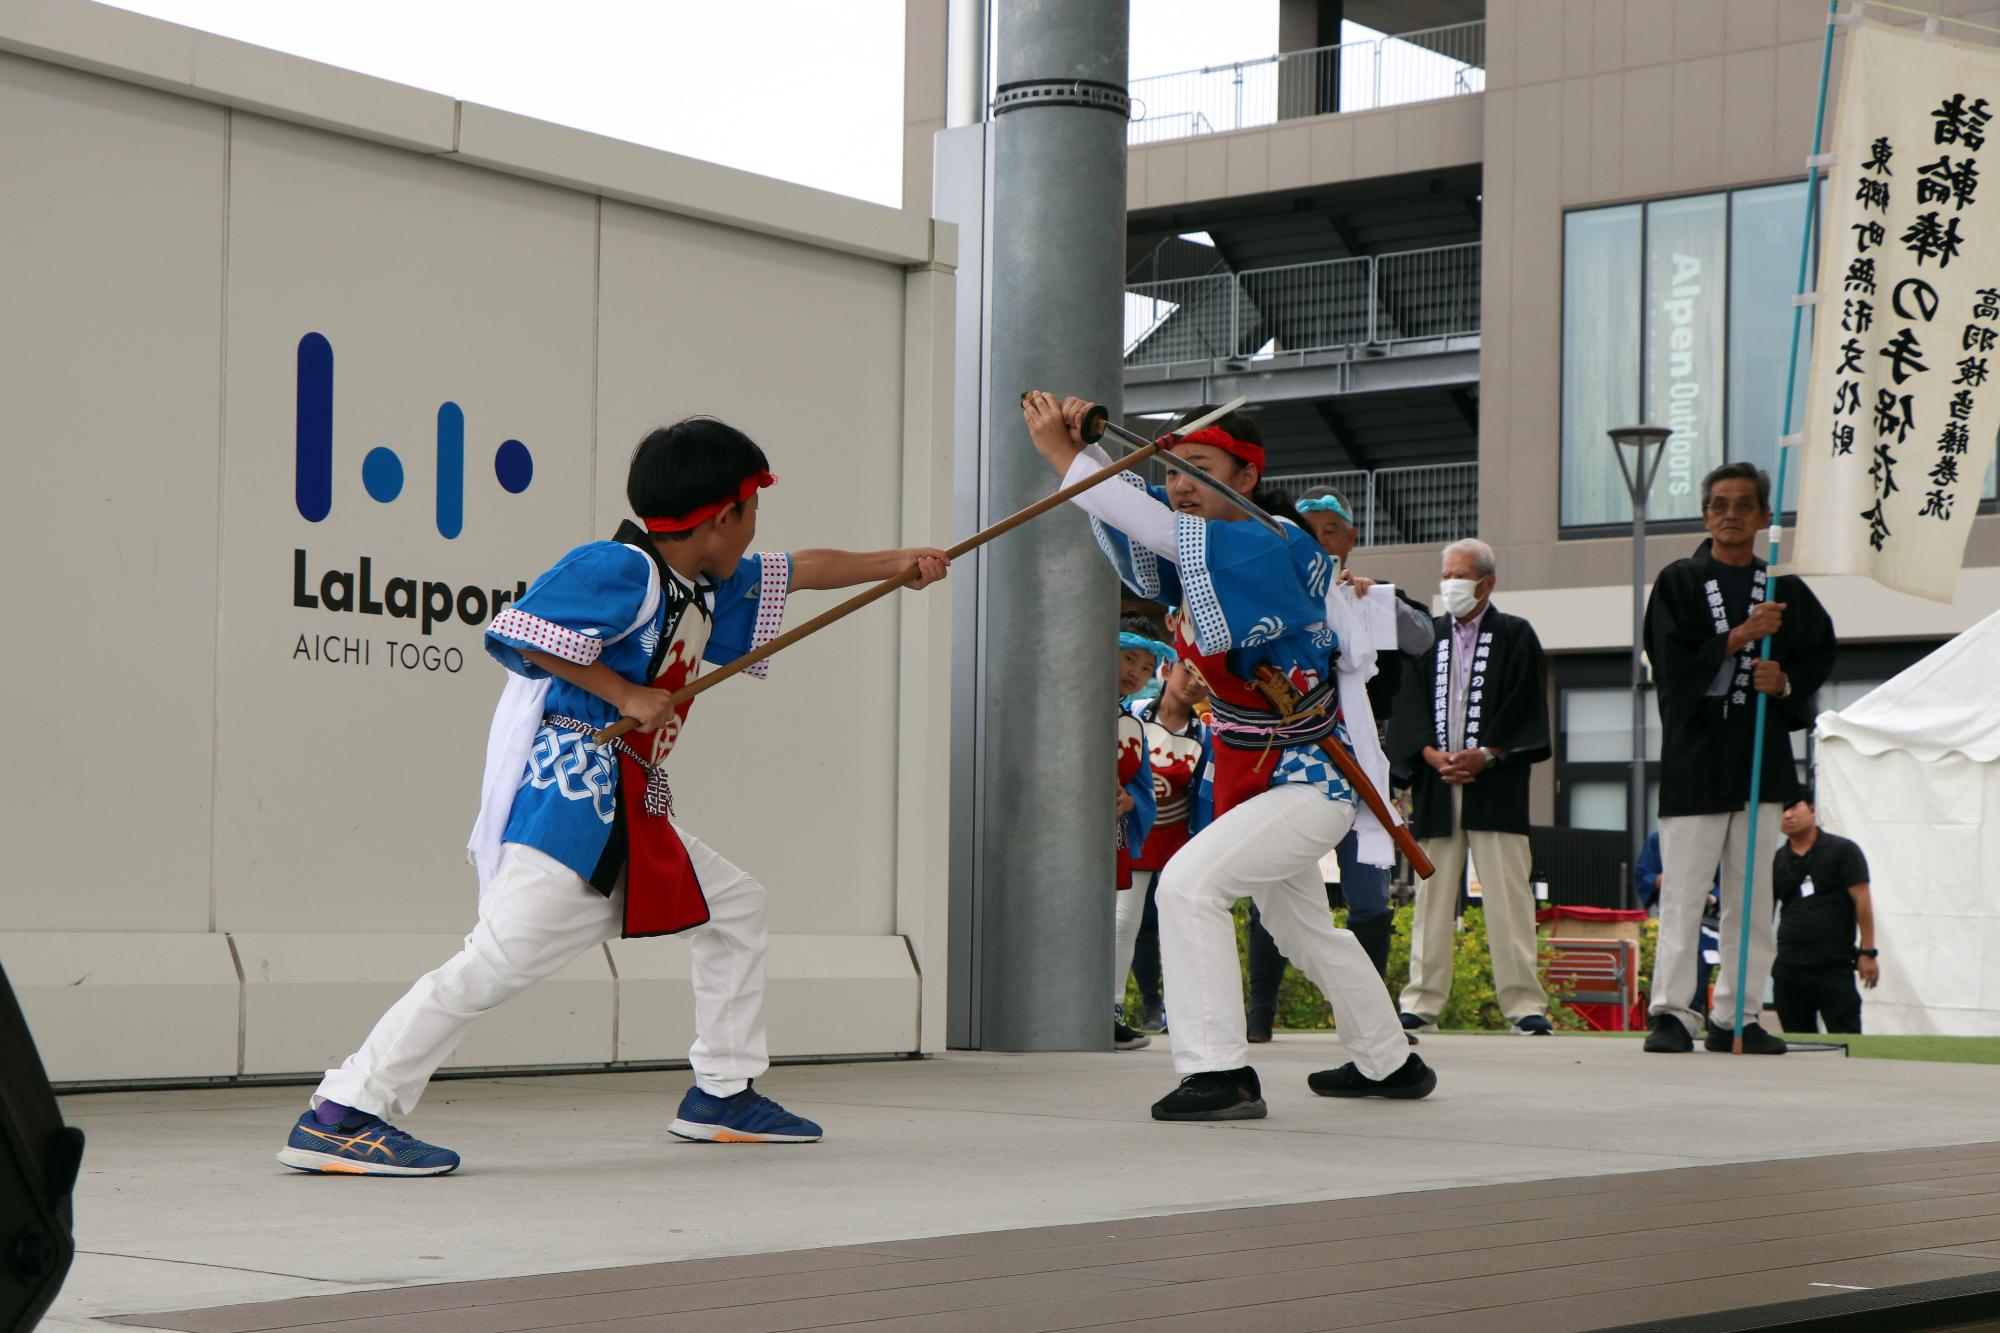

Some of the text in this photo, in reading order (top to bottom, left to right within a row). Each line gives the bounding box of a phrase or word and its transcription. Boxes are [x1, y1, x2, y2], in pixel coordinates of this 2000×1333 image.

[1664, 252, 1700, 496] Alpen Outdoors
[292, 633, 464, 673] AICHI TOGO
